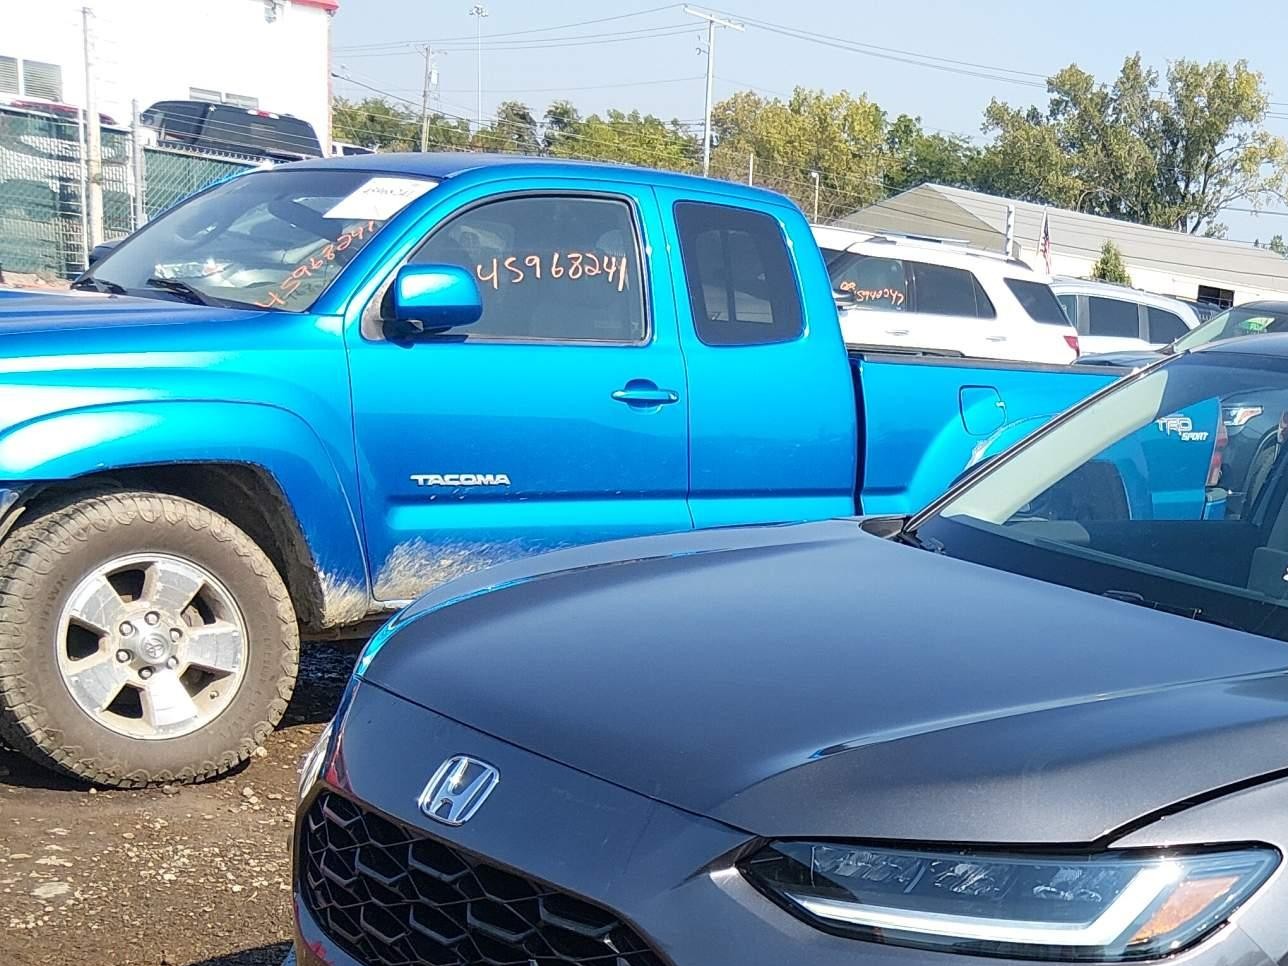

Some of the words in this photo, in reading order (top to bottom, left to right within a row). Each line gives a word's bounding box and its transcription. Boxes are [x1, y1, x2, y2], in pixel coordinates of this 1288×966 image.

[476, 253, 627, 292] 45968241
[1155, 417, 1193, 436] TRD
[1181, 432, 1209, 441] SPORT
[410, 474, 511, 486] TACOMA
